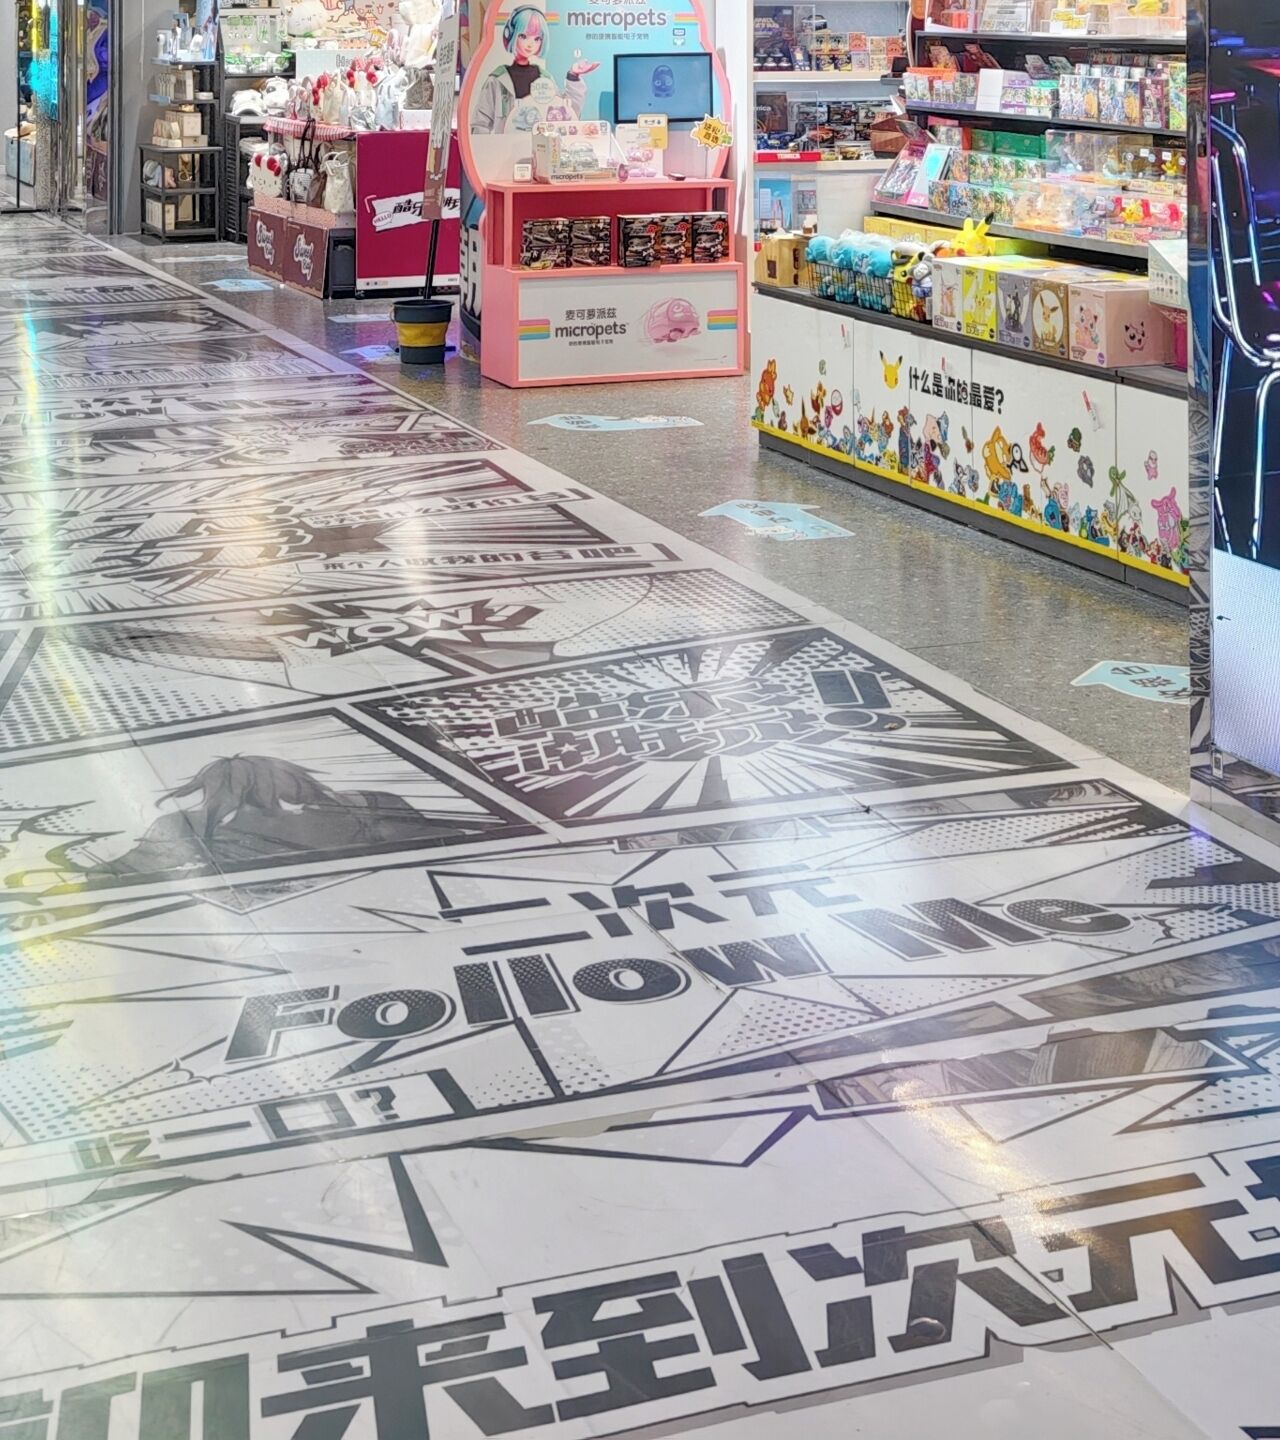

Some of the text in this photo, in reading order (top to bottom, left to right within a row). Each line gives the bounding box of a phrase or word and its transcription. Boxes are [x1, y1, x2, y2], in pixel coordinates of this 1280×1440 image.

[567, 8, 667, 31] micropets
[393, 198, 460, 217] 酷乐
[555, 322, 627, 340] micropets
[908, 365, 1005, 415] 什么是你的最爱?
[438, 863, 862, 956] 二次元
[220, 894, 1136, 1063] Follow Me
